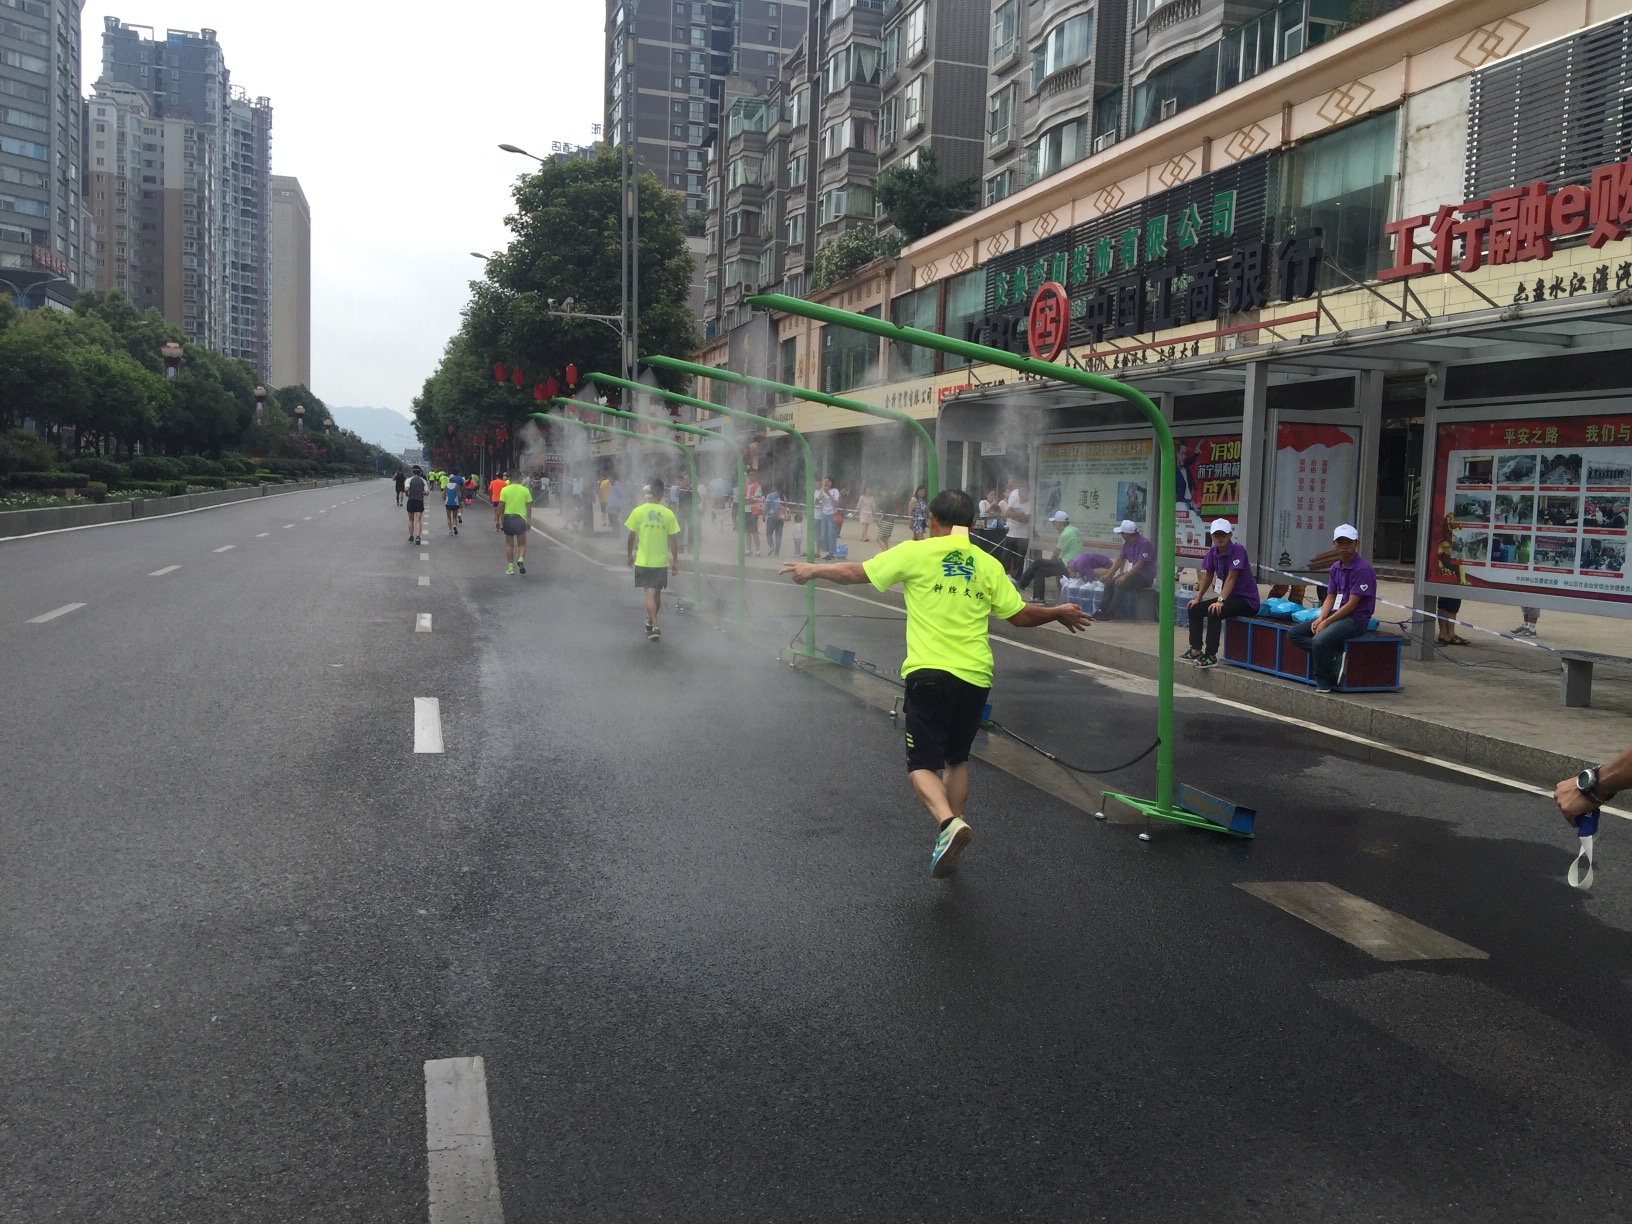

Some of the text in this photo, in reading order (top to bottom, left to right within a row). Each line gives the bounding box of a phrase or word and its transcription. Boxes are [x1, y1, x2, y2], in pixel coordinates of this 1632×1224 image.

[1085, 227, 1324, 342] 中国工商银行
[1503, 427, 1559, 445] 平安之路
